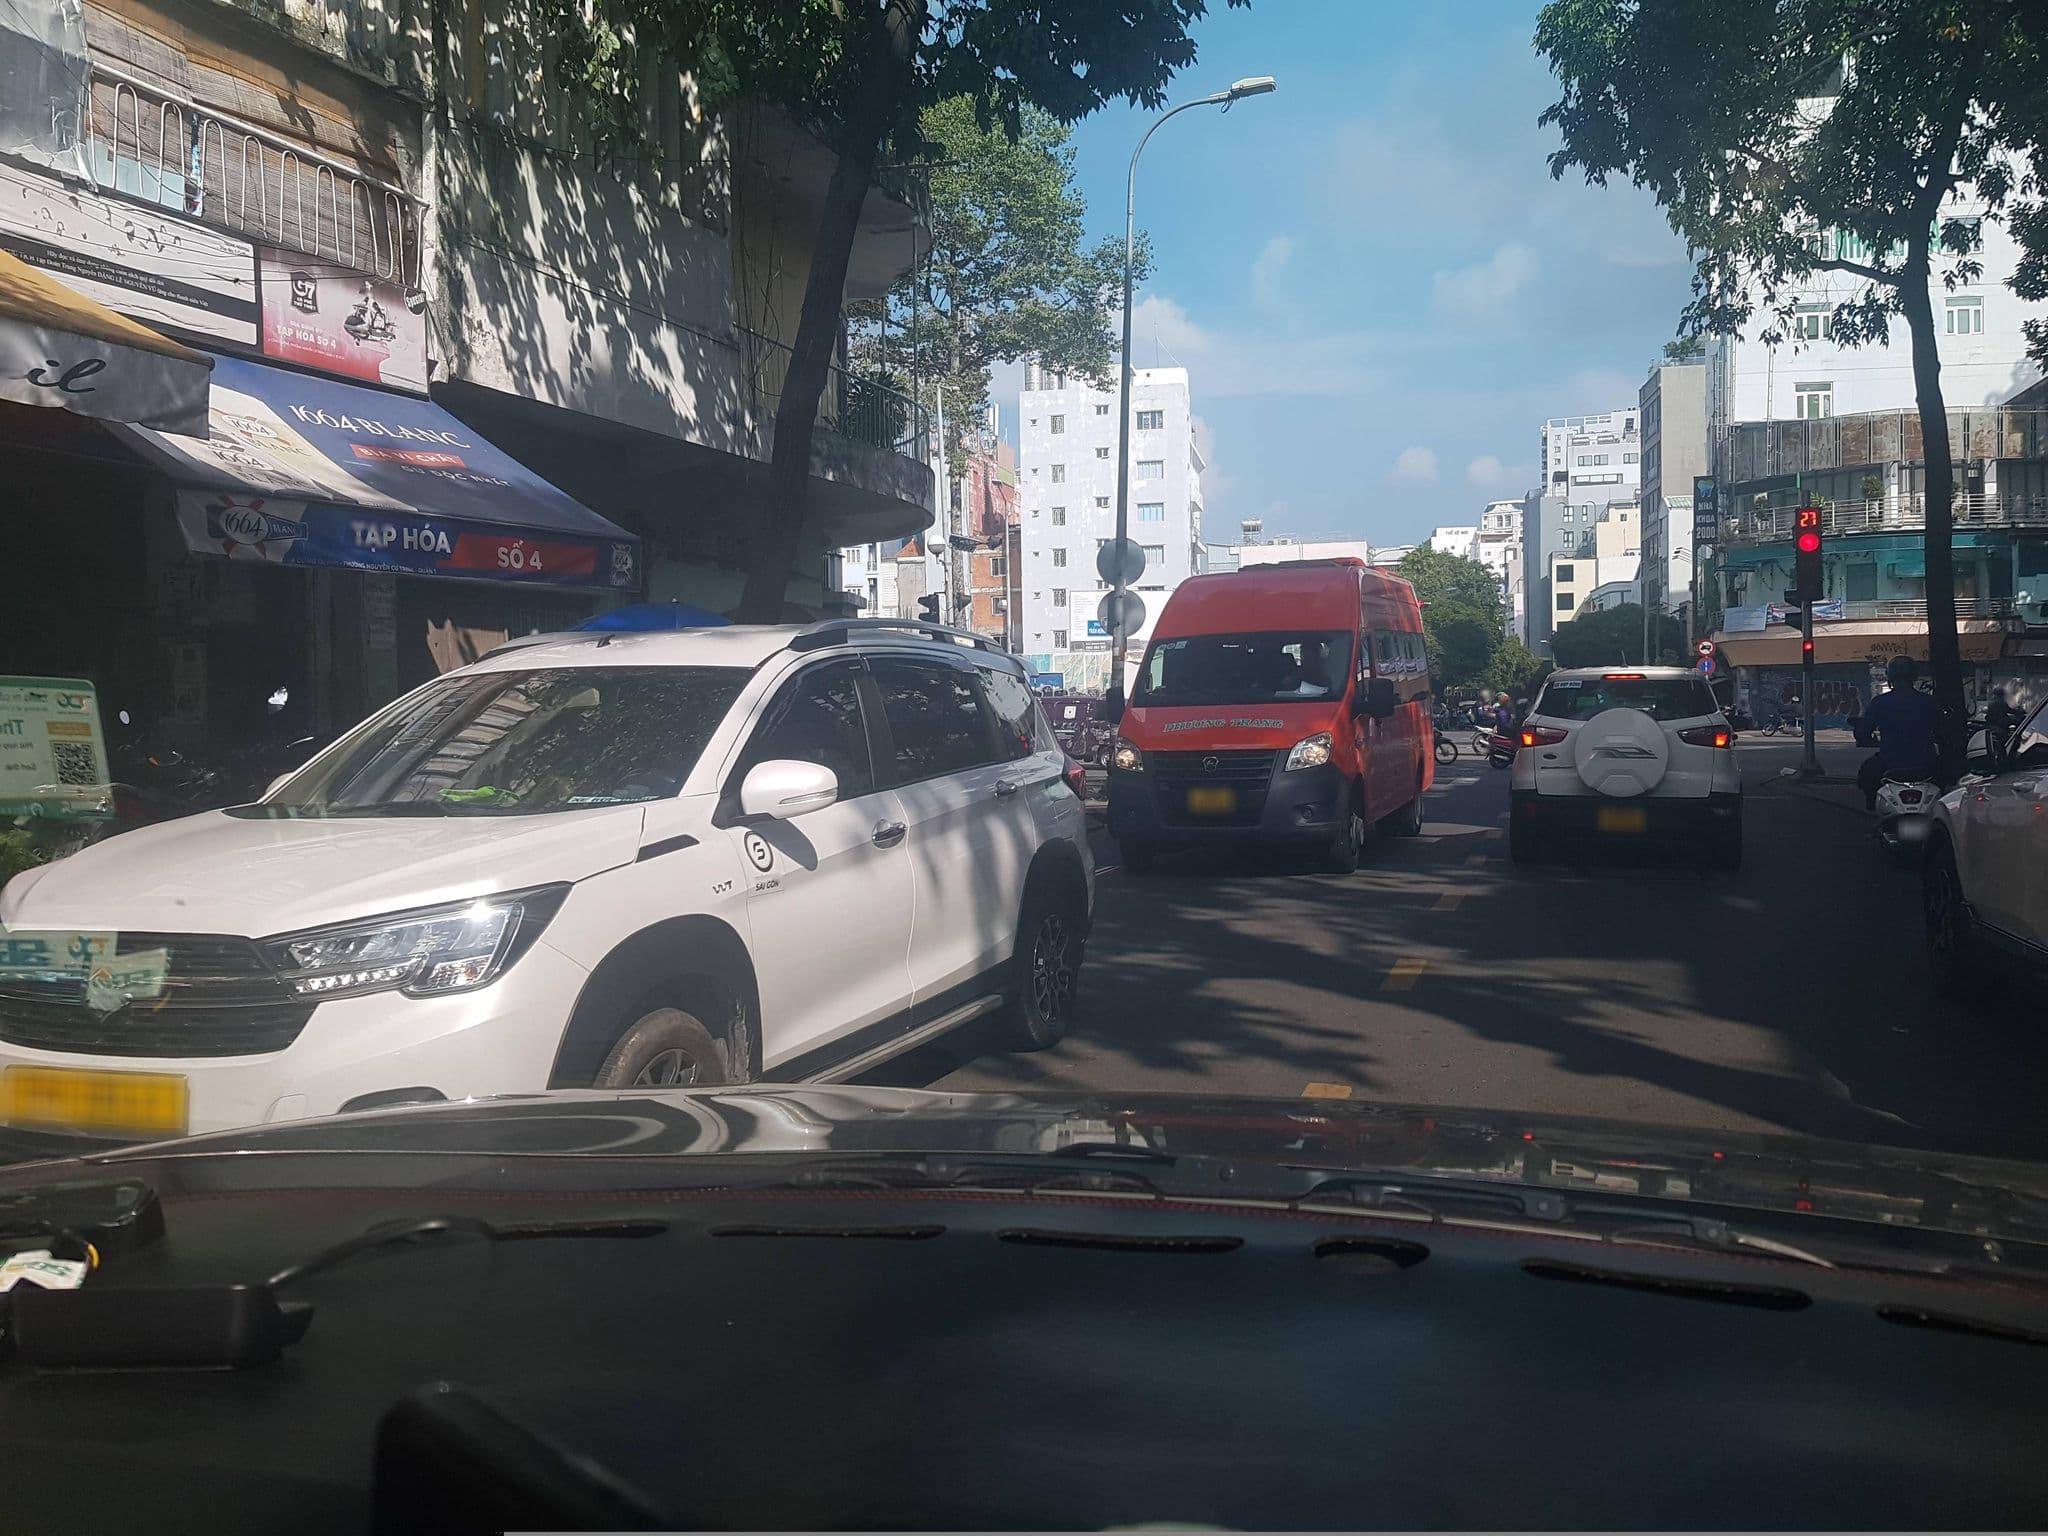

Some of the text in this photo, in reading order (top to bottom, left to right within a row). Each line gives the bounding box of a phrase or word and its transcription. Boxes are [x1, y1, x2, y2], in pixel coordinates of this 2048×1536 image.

[293, 280, 315, 299] G7
[288, 405, 472, 449] 1664 BLANC
[1698, 502, 1713, 510] NHA
[224, 513, 263, 537] 1664
[1696, 514, 1716, 523] KHOA
[1799, 511, 1818, 528] 27
[1696, 526, 1716, 539] 2000
[351, 520, 543, 570] TẠP HÓA SỐ 4
[1230, 718, 1284, 729] TRANG
